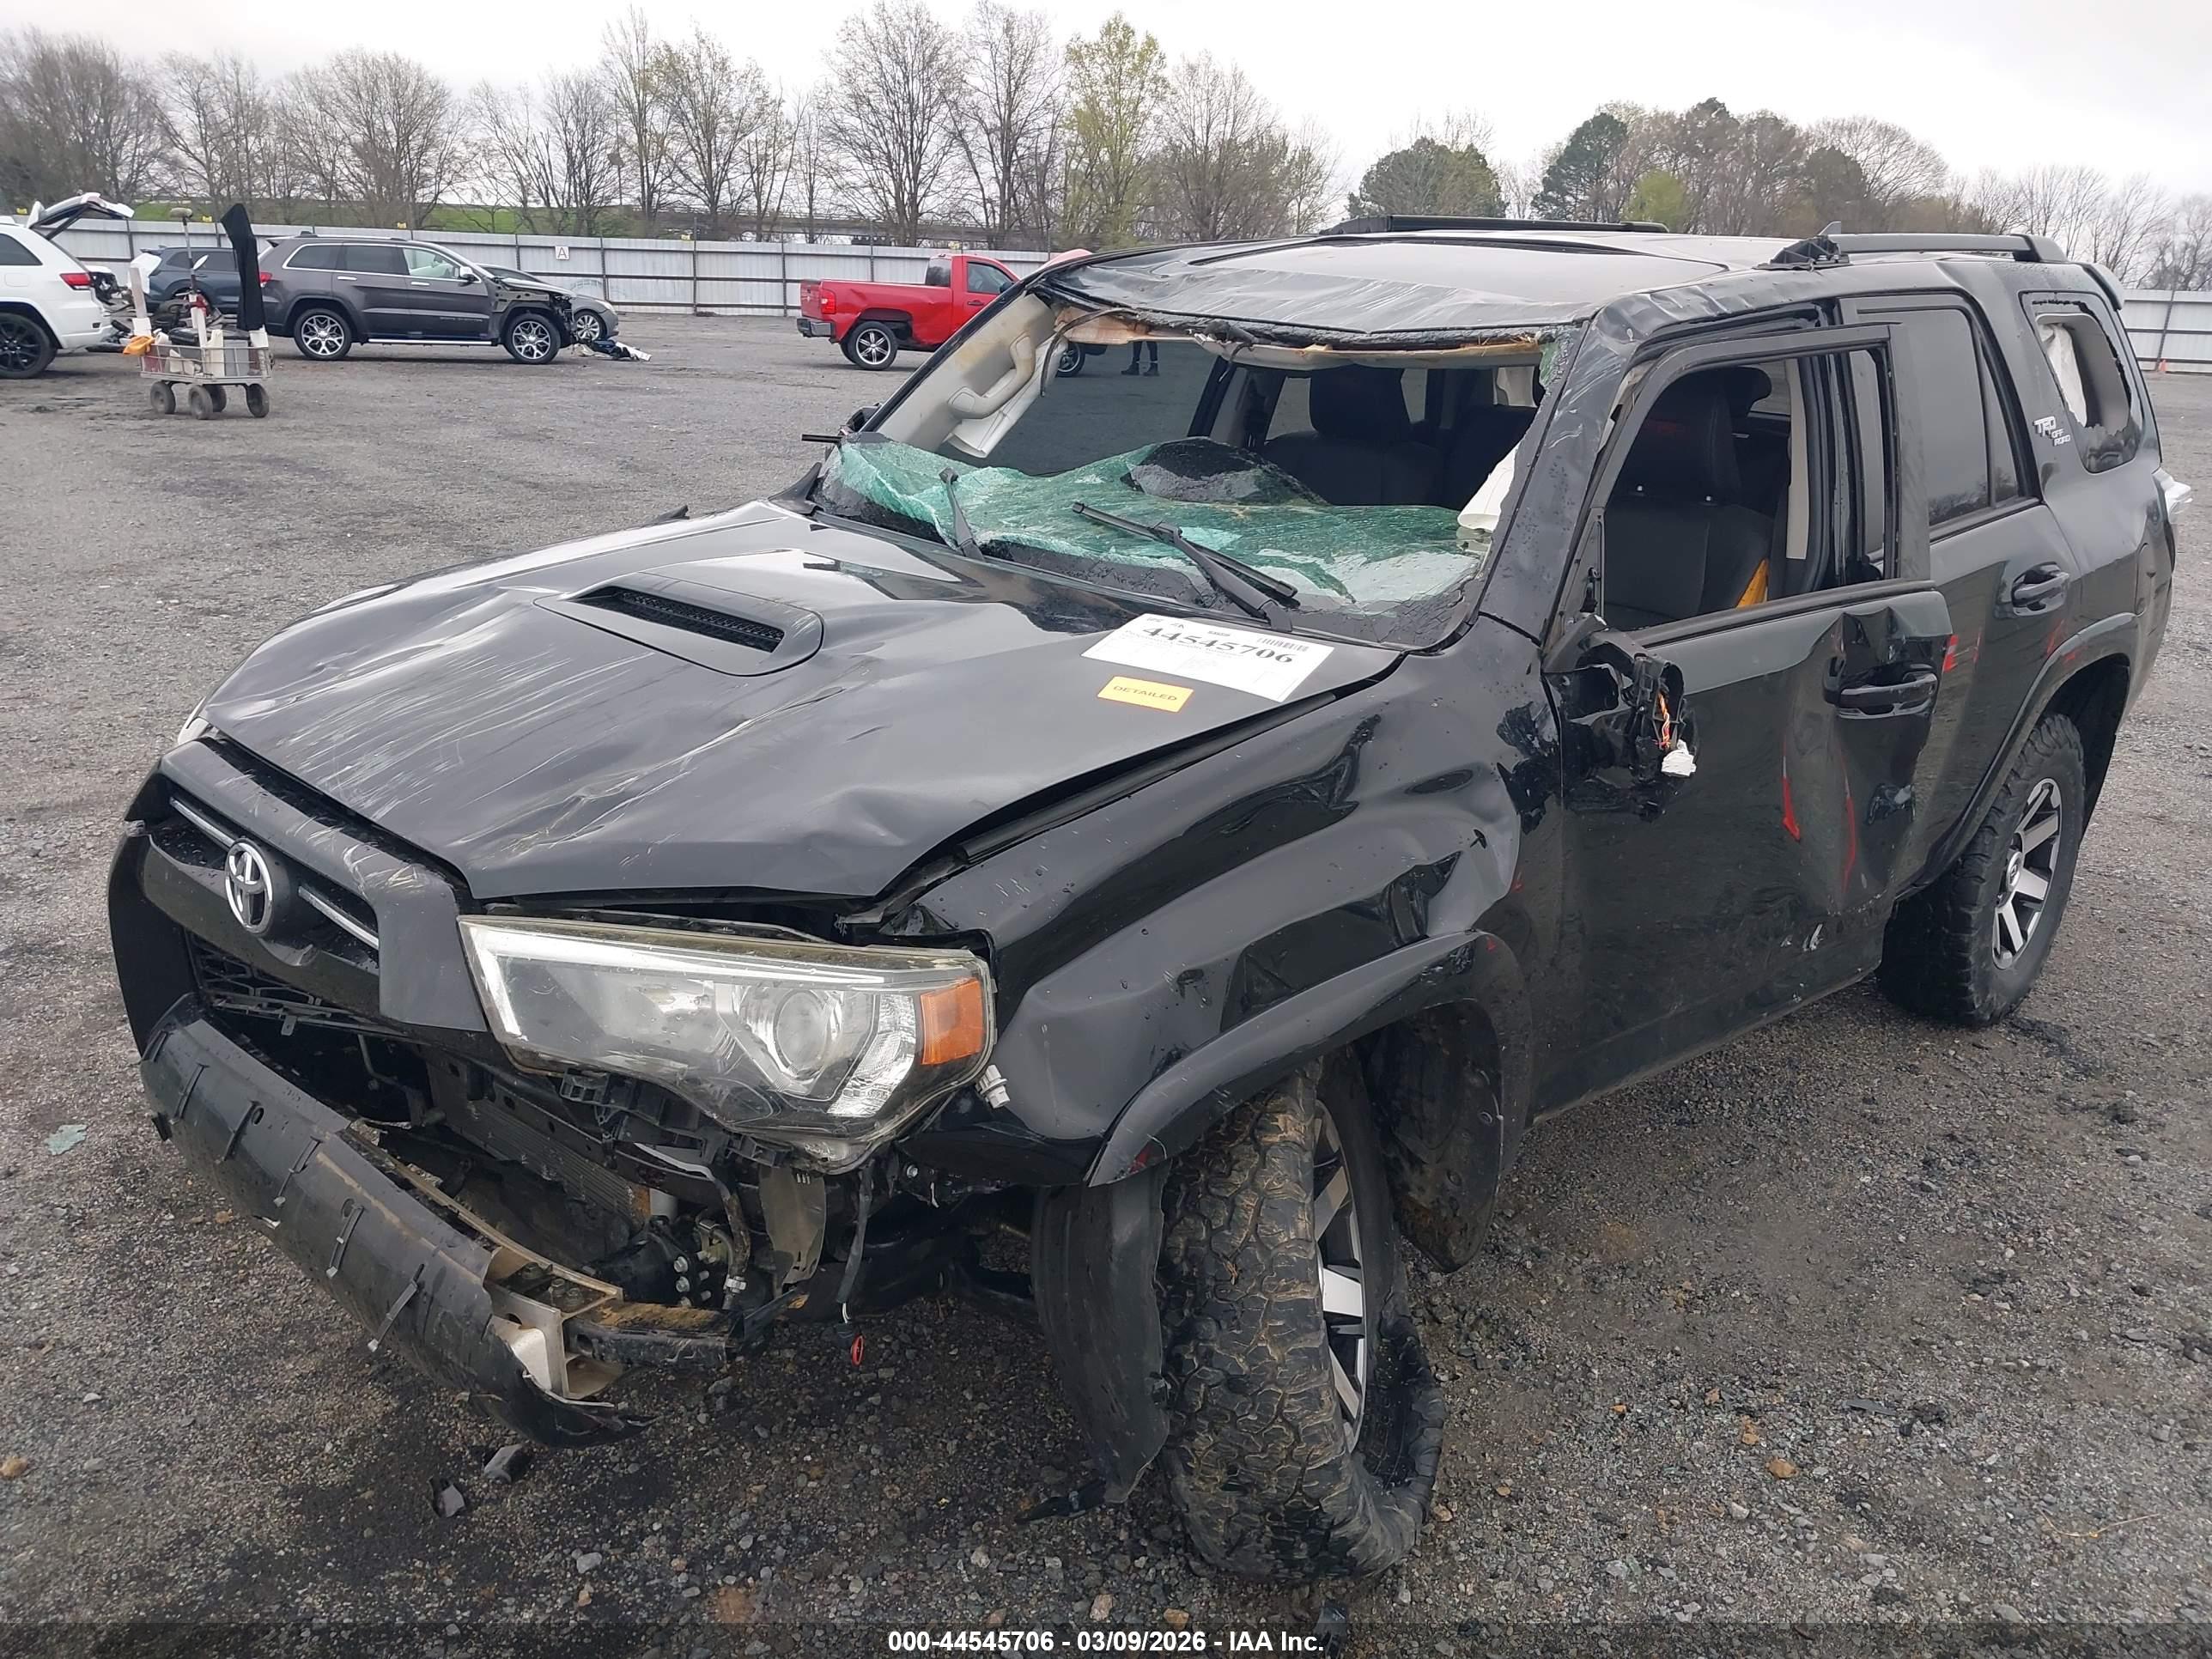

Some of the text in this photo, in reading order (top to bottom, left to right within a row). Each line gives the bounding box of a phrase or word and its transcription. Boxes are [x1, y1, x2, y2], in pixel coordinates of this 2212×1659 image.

[557, 246, 568, 258] A
[2033, 416, 2057, 437] TRD
[1143, 628, 1296, 663] 44545706
[1113, 686, 1178, 701] DETAILED
